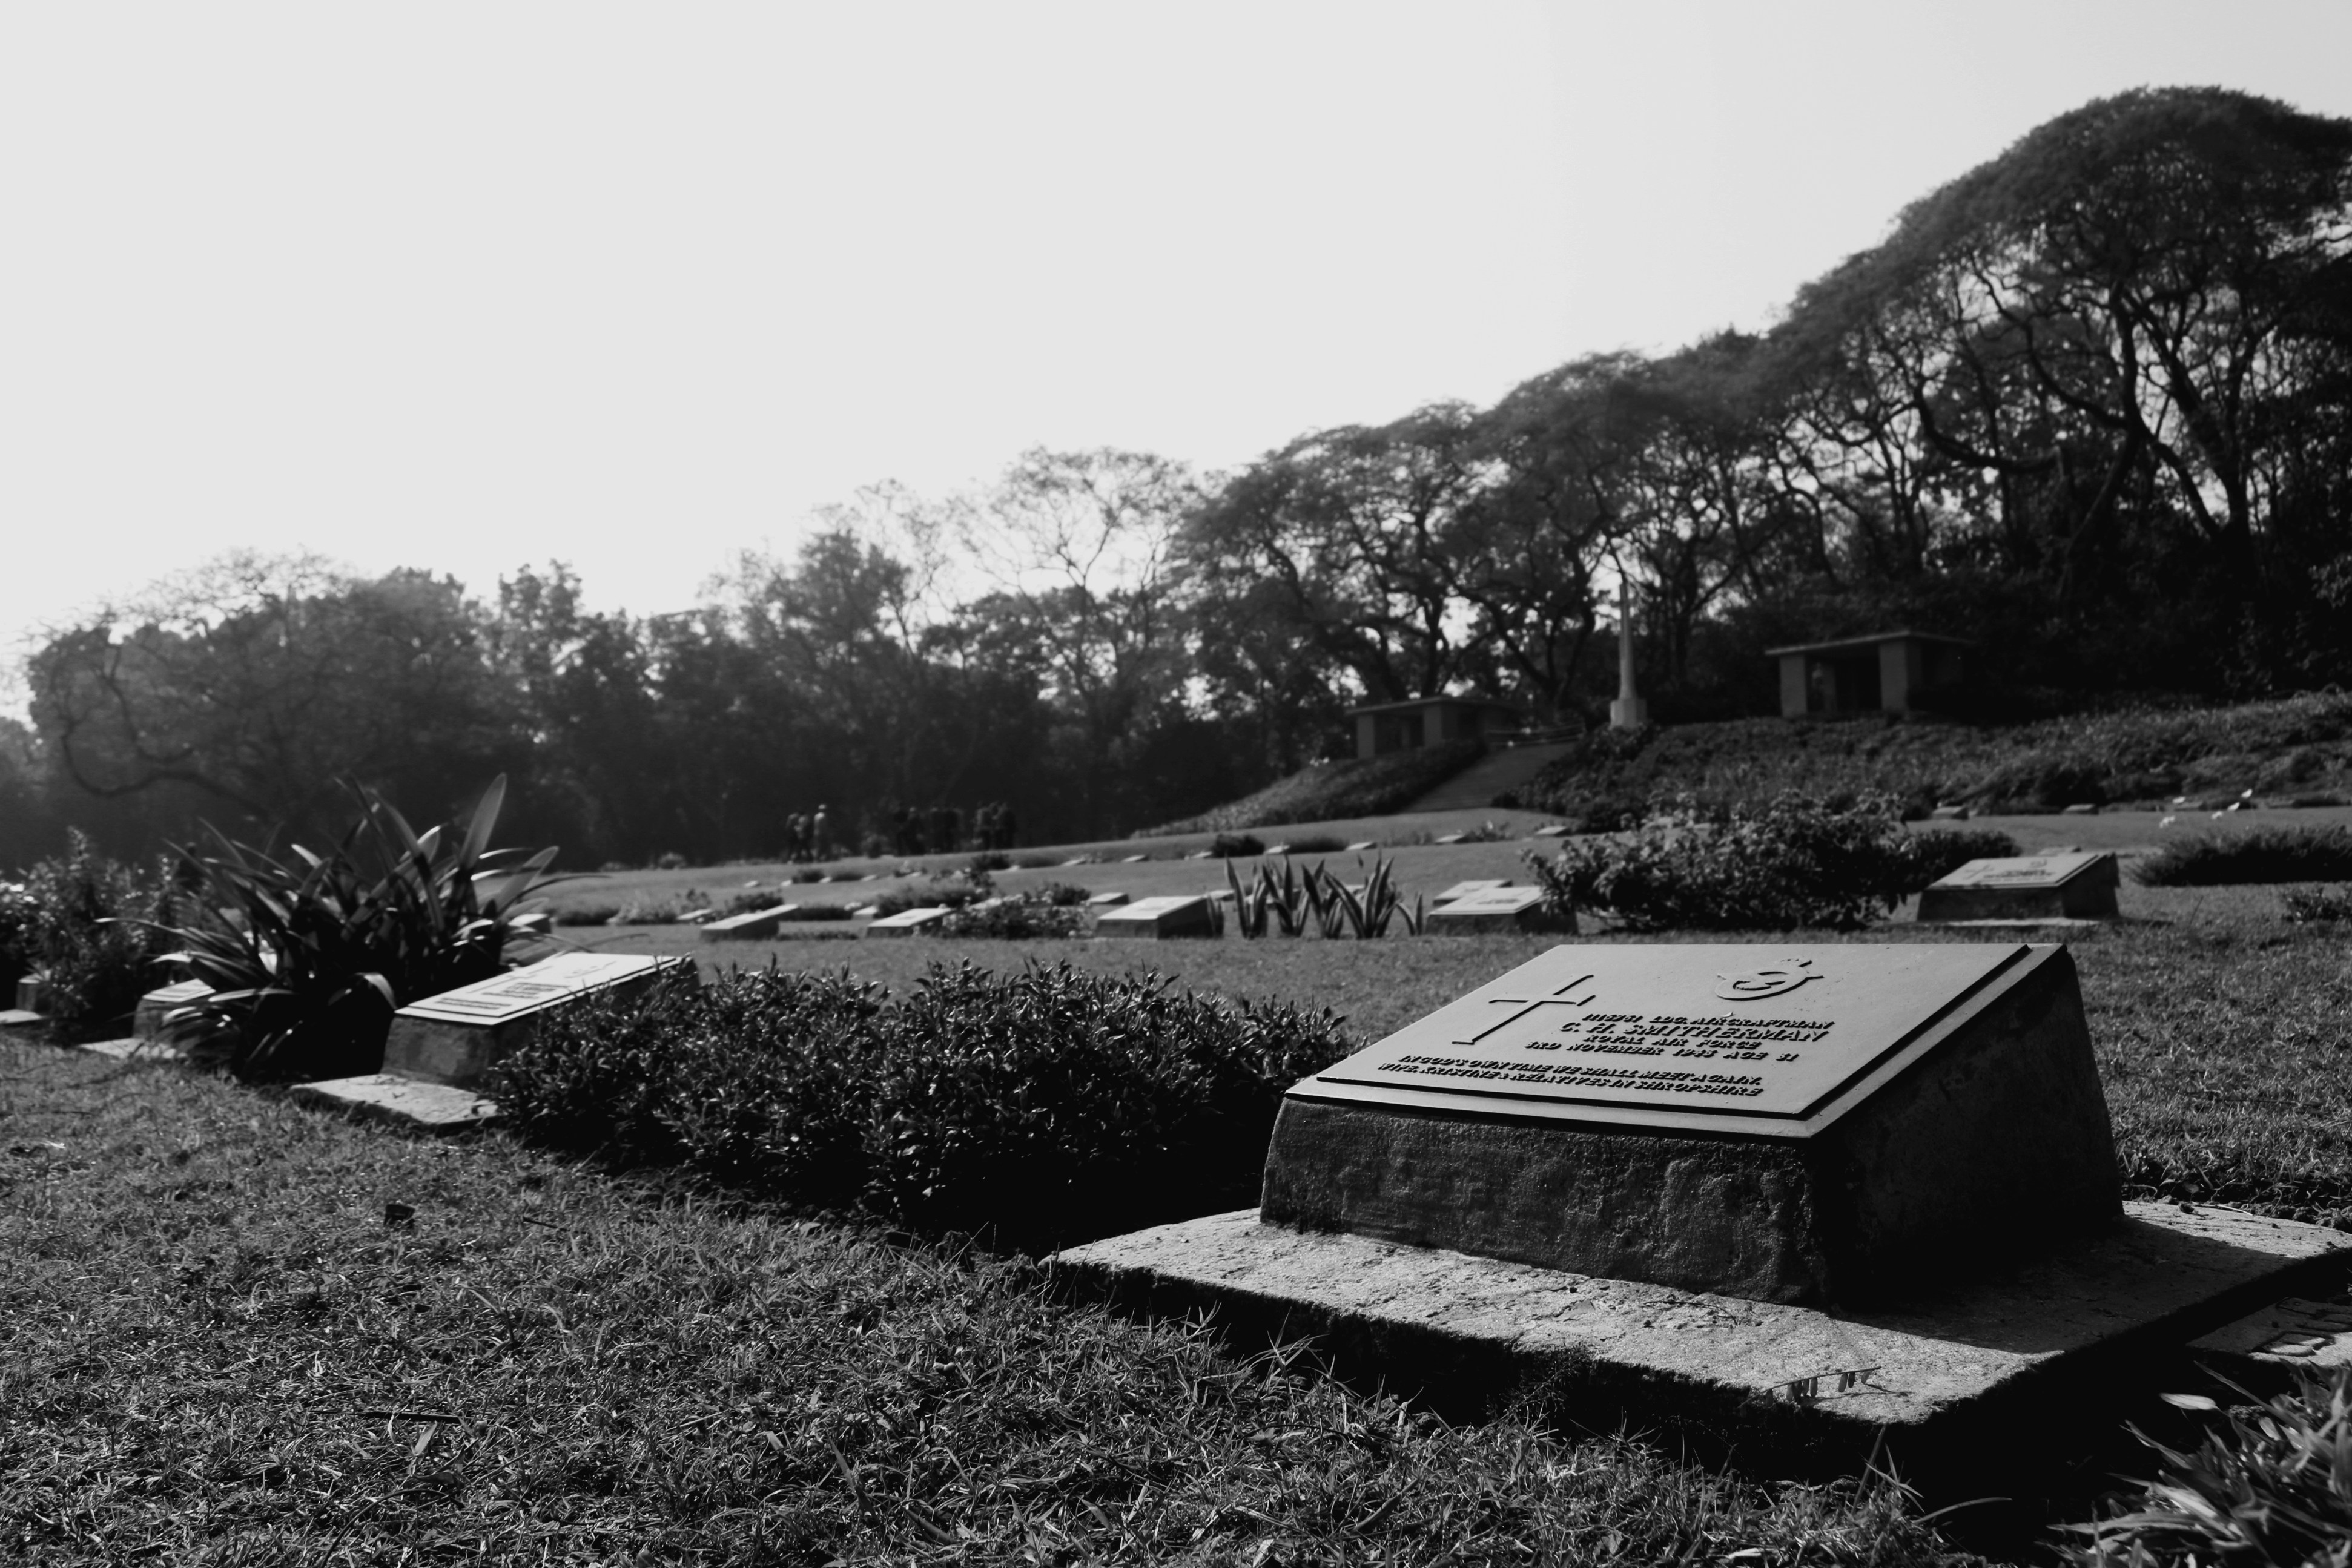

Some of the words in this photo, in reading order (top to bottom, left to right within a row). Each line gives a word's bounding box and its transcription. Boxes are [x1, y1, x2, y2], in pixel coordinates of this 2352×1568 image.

[1559, 1021, 1582, 1033] C.
[1585, 1022, 1617, 1035] H.
[1623, 1024, 1830, 1043] SMITHERMAN
[1690, 1015, 1835, 1030] AIRCRAFTMAN
[1524, 1041, 1562, 1050] 3RD
[1565, 1043, 1665, 1056] NOVEMBER
[1722, 1050, 1769, 1061] AGE
[1582, 1034, 1646, 1045] ROYAL
[1651, 1037, 1690, 1047] AIR
[1696, 1038, 1763, 1050] FORCE
[1398, 1055, 1422, 1064] IN
[1418, 1056, 1470, 1067] GOD'S
[1468, 1059, 1511, 1070] OWN
[1507, 1062, 1554, 1073] TIME
[1552, 1064, 1583, 1075] WE
[1579, 1067, 1639, 1079] SHALL
[1637, 1070, 1695, 1082] MEET
[1690, 1073, 1763, 1086] AGAIN.
[1418, 1066, 1501, 1079] KRISTINE
[1509, 1072, 1611, 1087] RELATIVES
[1608, 1078, 1637, 1089] IN
[1633, 1080, 1765, 1097] SHROPSHIRE
